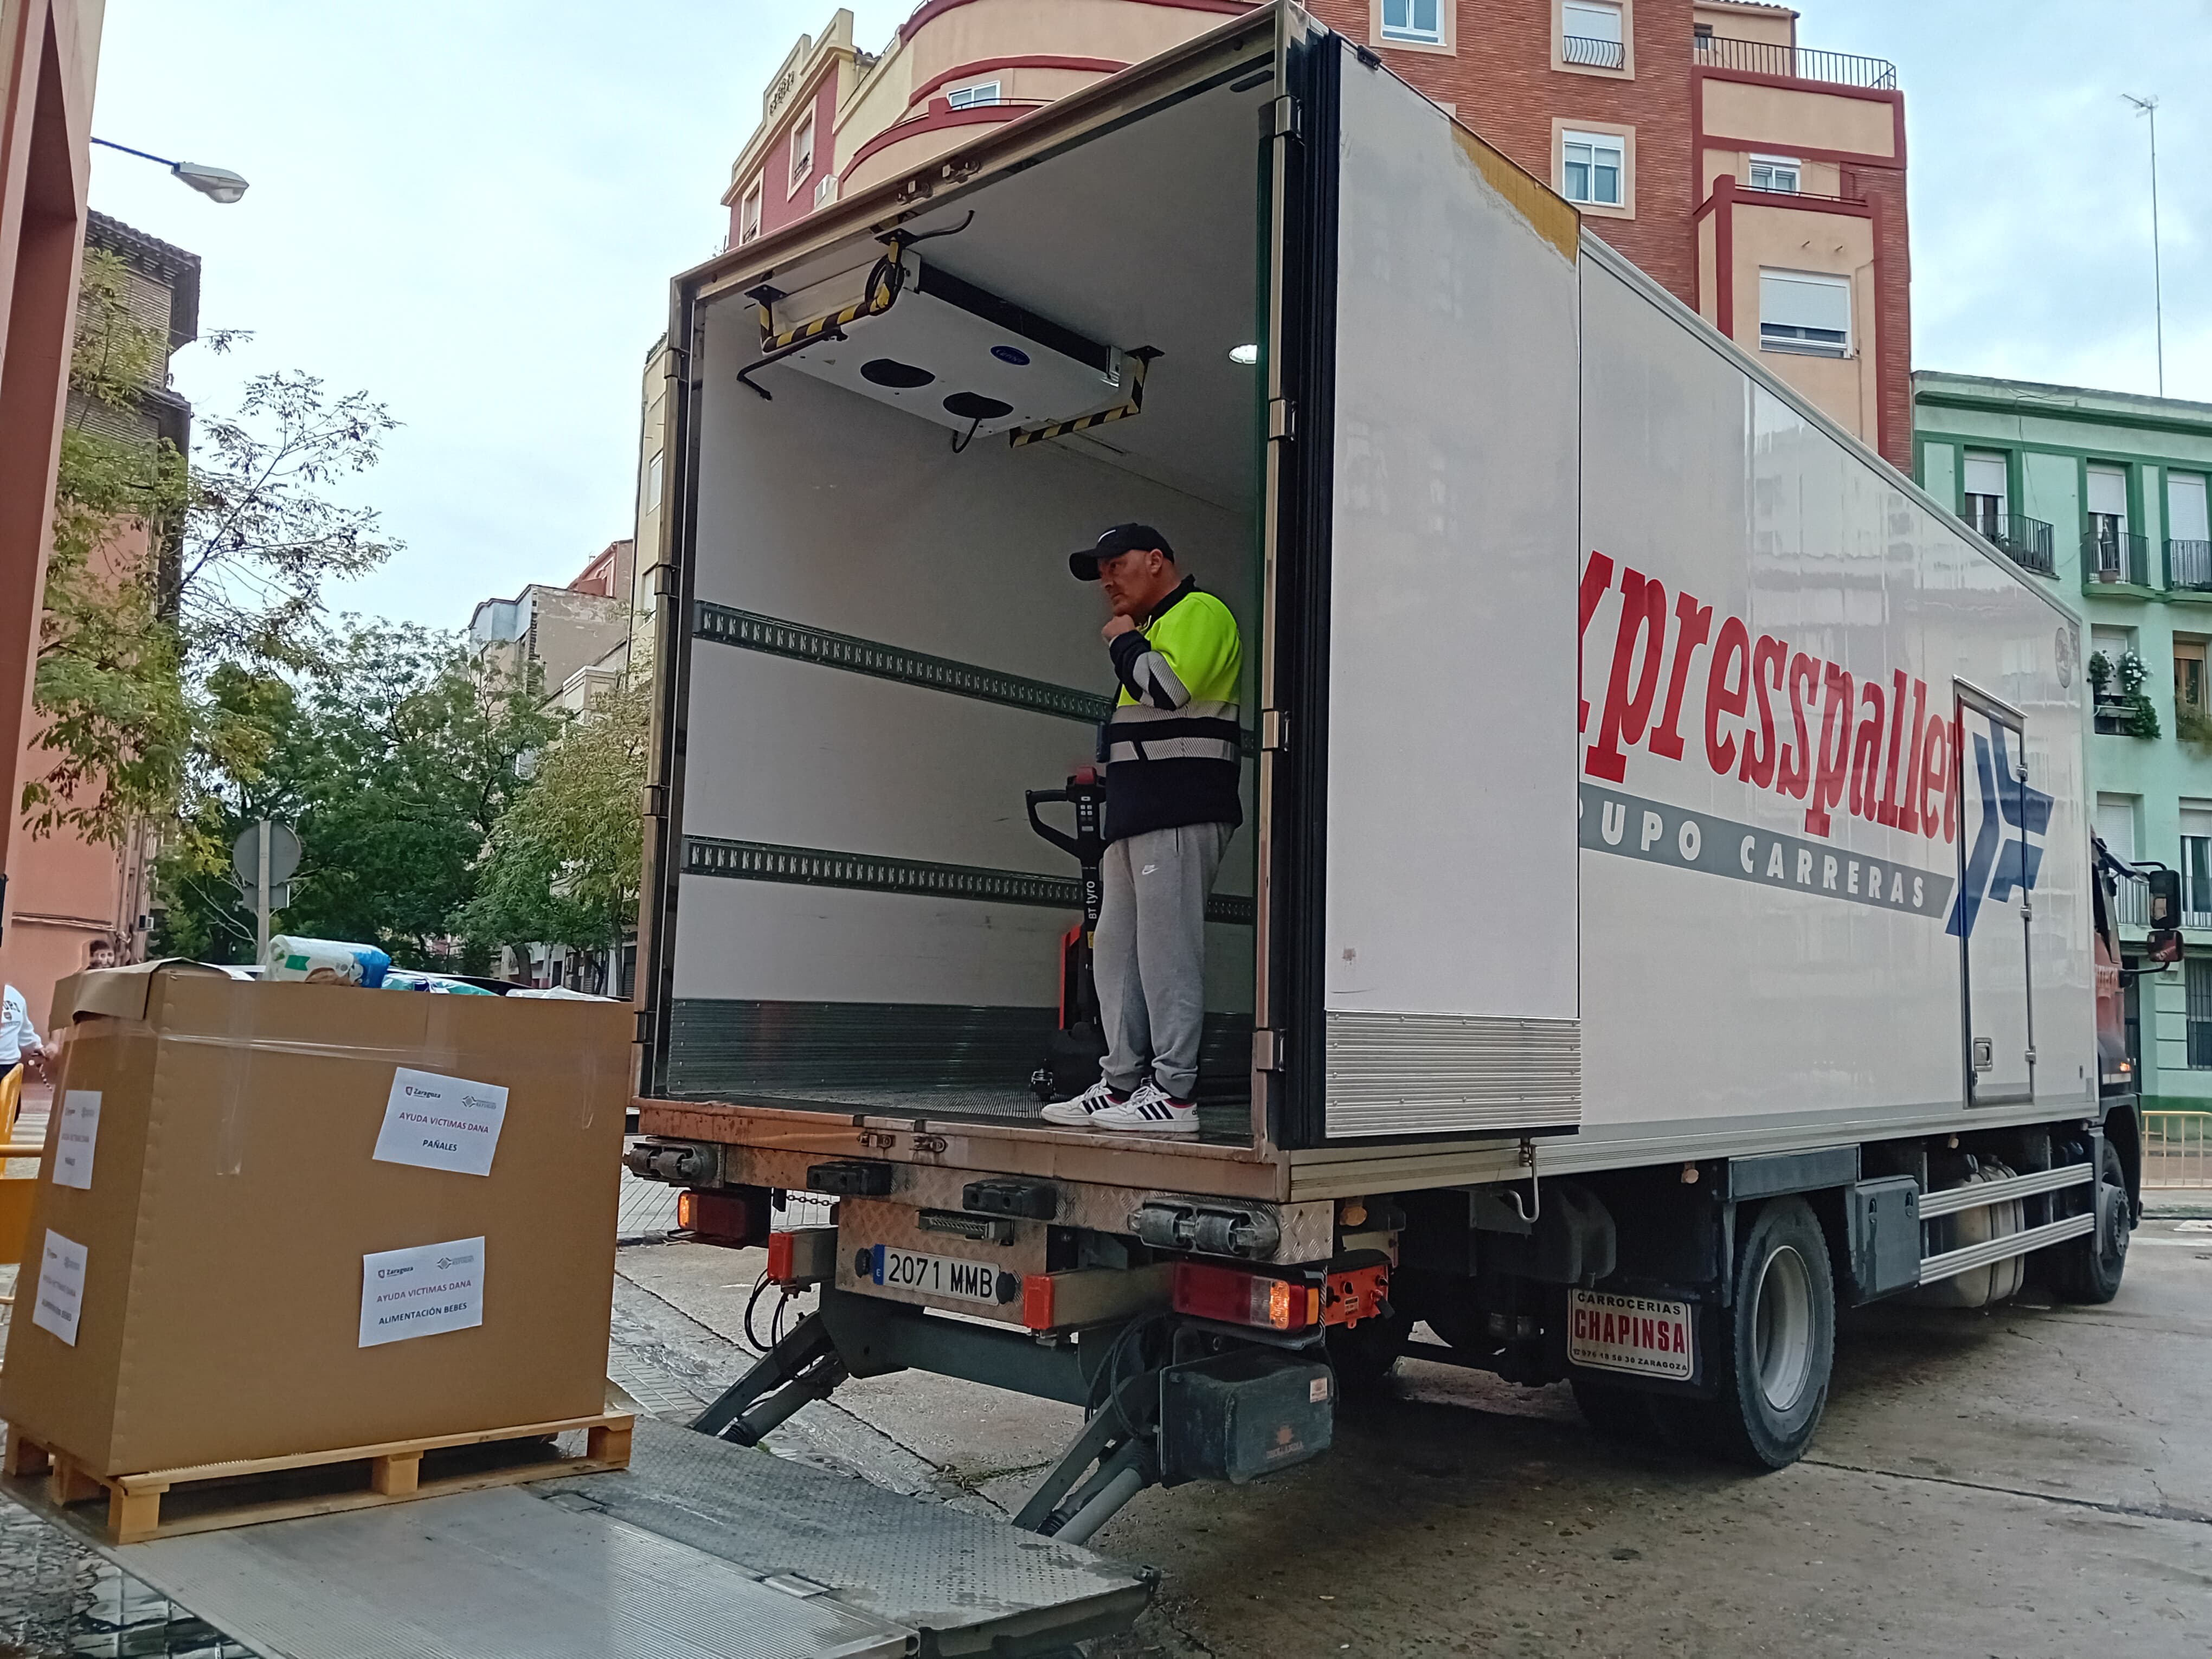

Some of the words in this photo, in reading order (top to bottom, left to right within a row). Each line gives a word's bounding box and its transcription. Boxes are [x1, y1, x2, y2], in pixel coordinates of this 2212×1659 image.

[1580, 798, 1701, 861] UPO
[1740, 835, 1924, 908] CARRERAS
[1085, 880, 1098, 904] tyro
[1088, 908, 1097, 919] BT
[413, 1088, 441, 1098] Zaragoza
[398, 1111, 427, 1123] AYUDA
[430, 1117, 466, 1130] VICTIMAS
[467, 1123, 489, 1133] DANA
[422, 1139, 458, 1152] PAÑALES
[386, 1266, 414, 1276] Zaragoza
[888, 1253, 940, 1290] 2071
[950, 1263, 993, 1298] MMB
[376, 1291, 406, 1303] AYUDA
[408, 1284, 447, 1297] VICTIMAS
[449, 1279, 472, 1290] DANA
[378, 1307, 442, 1325] ALIMENTACIÓN
[443, 1302, 467, 1314] BEBES
[1578, 1293, 1681, 1315] CARROCERIAS
[1574, 1308, 1686, 1354] CHAPINSA
[1638, 1358, 1687, 1371] ZARAGOZA
